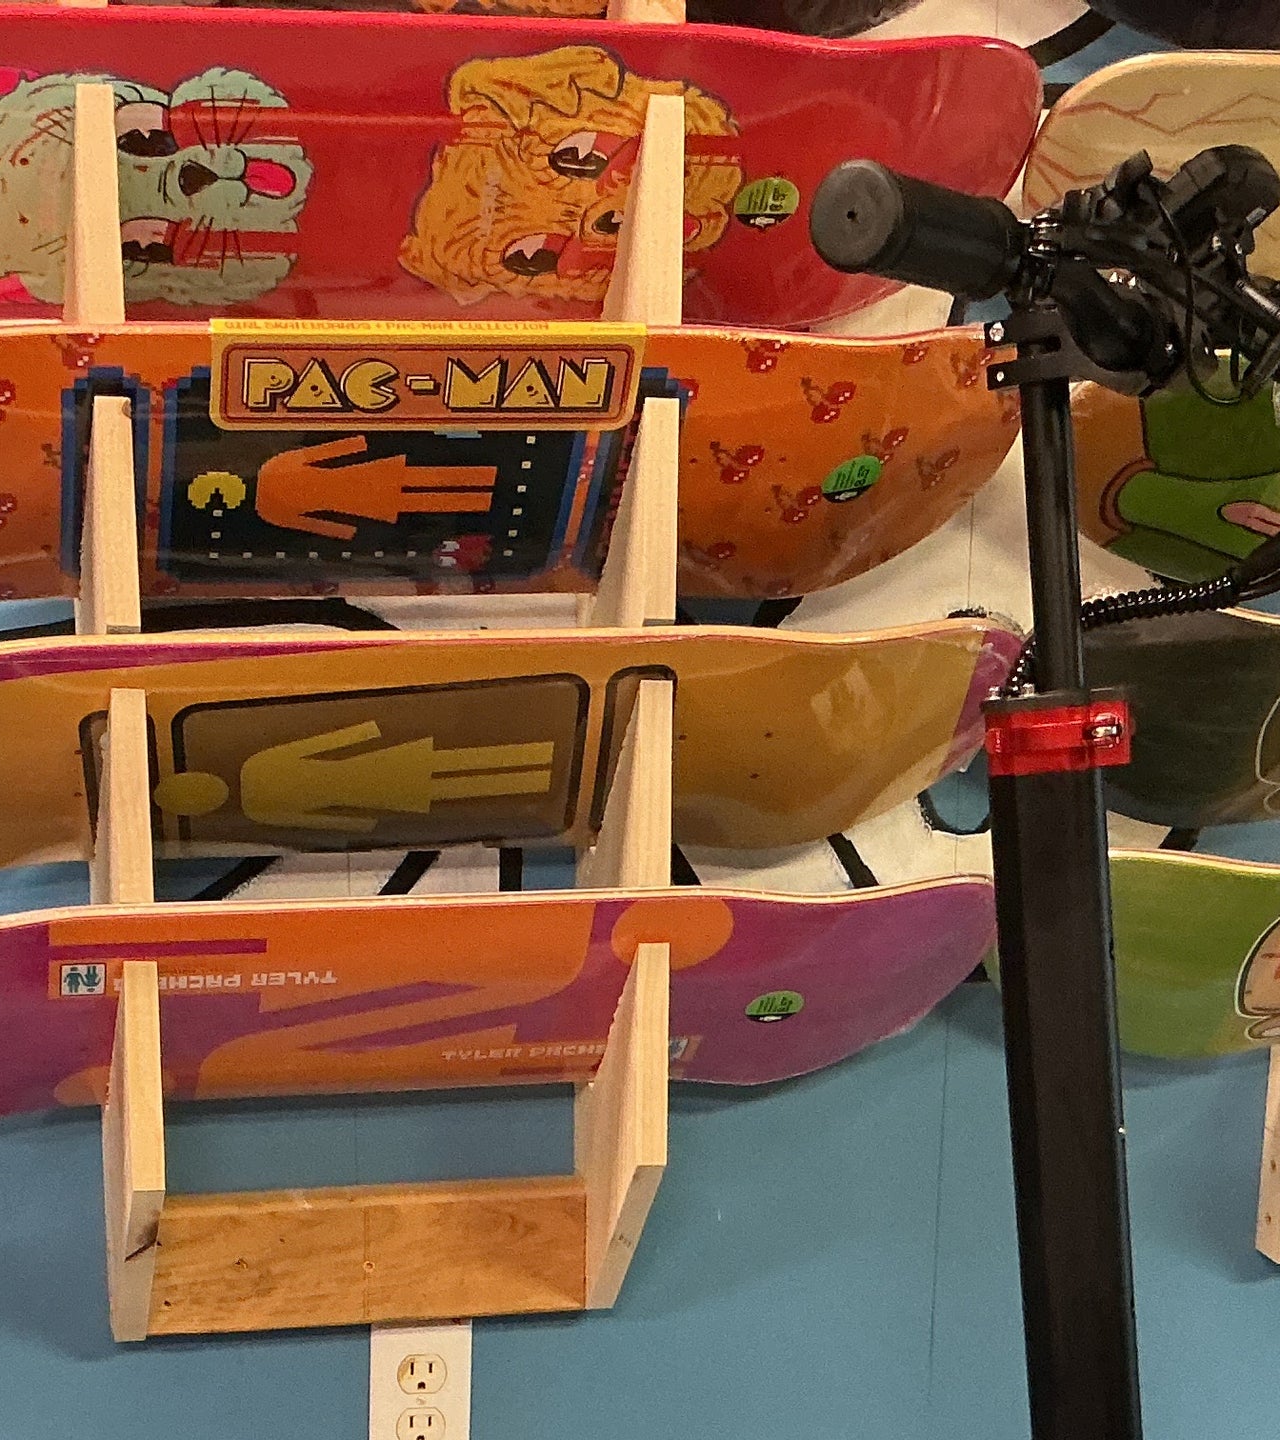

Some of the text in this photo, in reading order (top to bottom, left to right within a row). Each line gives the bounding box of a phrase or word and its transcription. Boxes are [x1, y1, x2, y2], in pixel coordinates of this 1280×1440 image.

[243, 356, 615, 413] PAC-MAN
[251, 970, 338, 986] TYLER
[441, 1048, 521, 1060] TYLER
